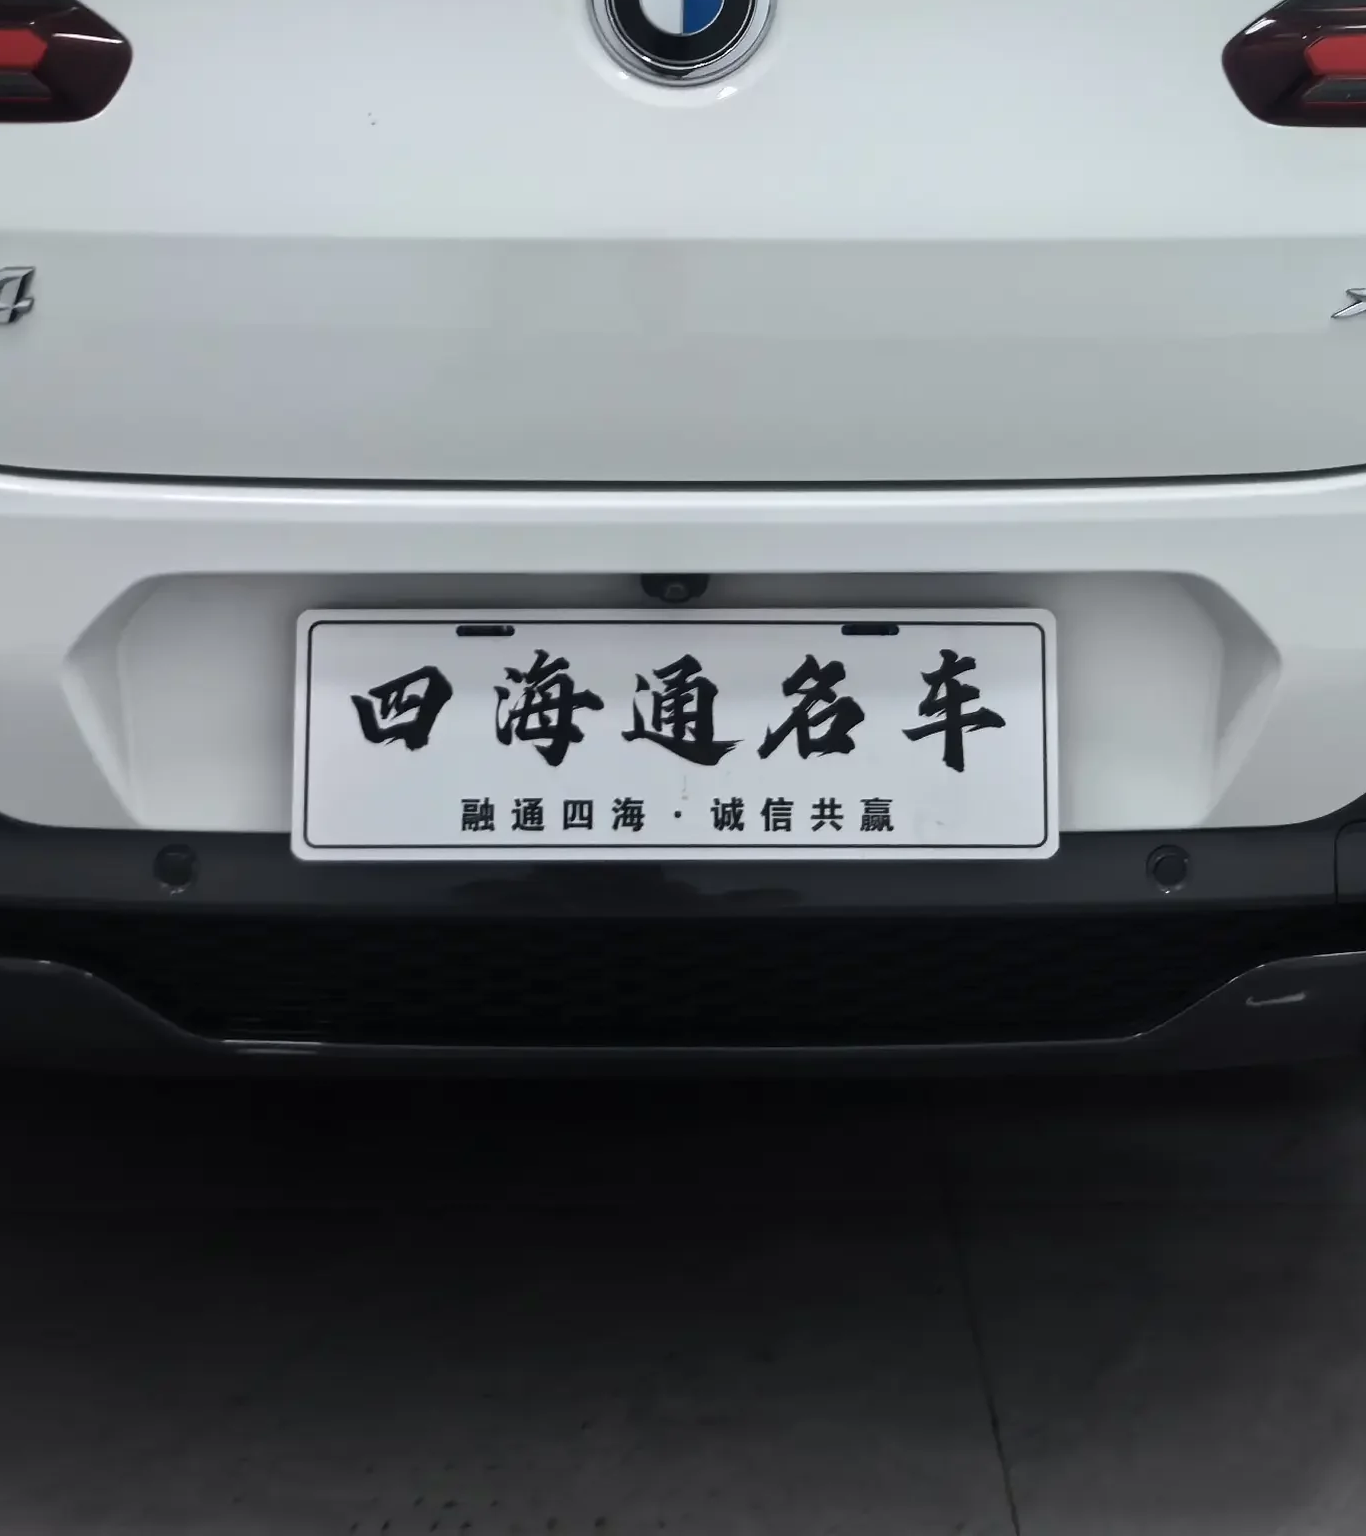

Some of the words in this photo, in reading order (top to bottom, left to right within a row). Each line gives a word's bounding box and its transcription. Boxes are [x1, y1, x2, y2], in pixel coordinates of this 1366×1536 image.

[350, 647, 1006, 773] 四海通名车
[460, 796, 896, 834] 融通四海·诚信共赢
